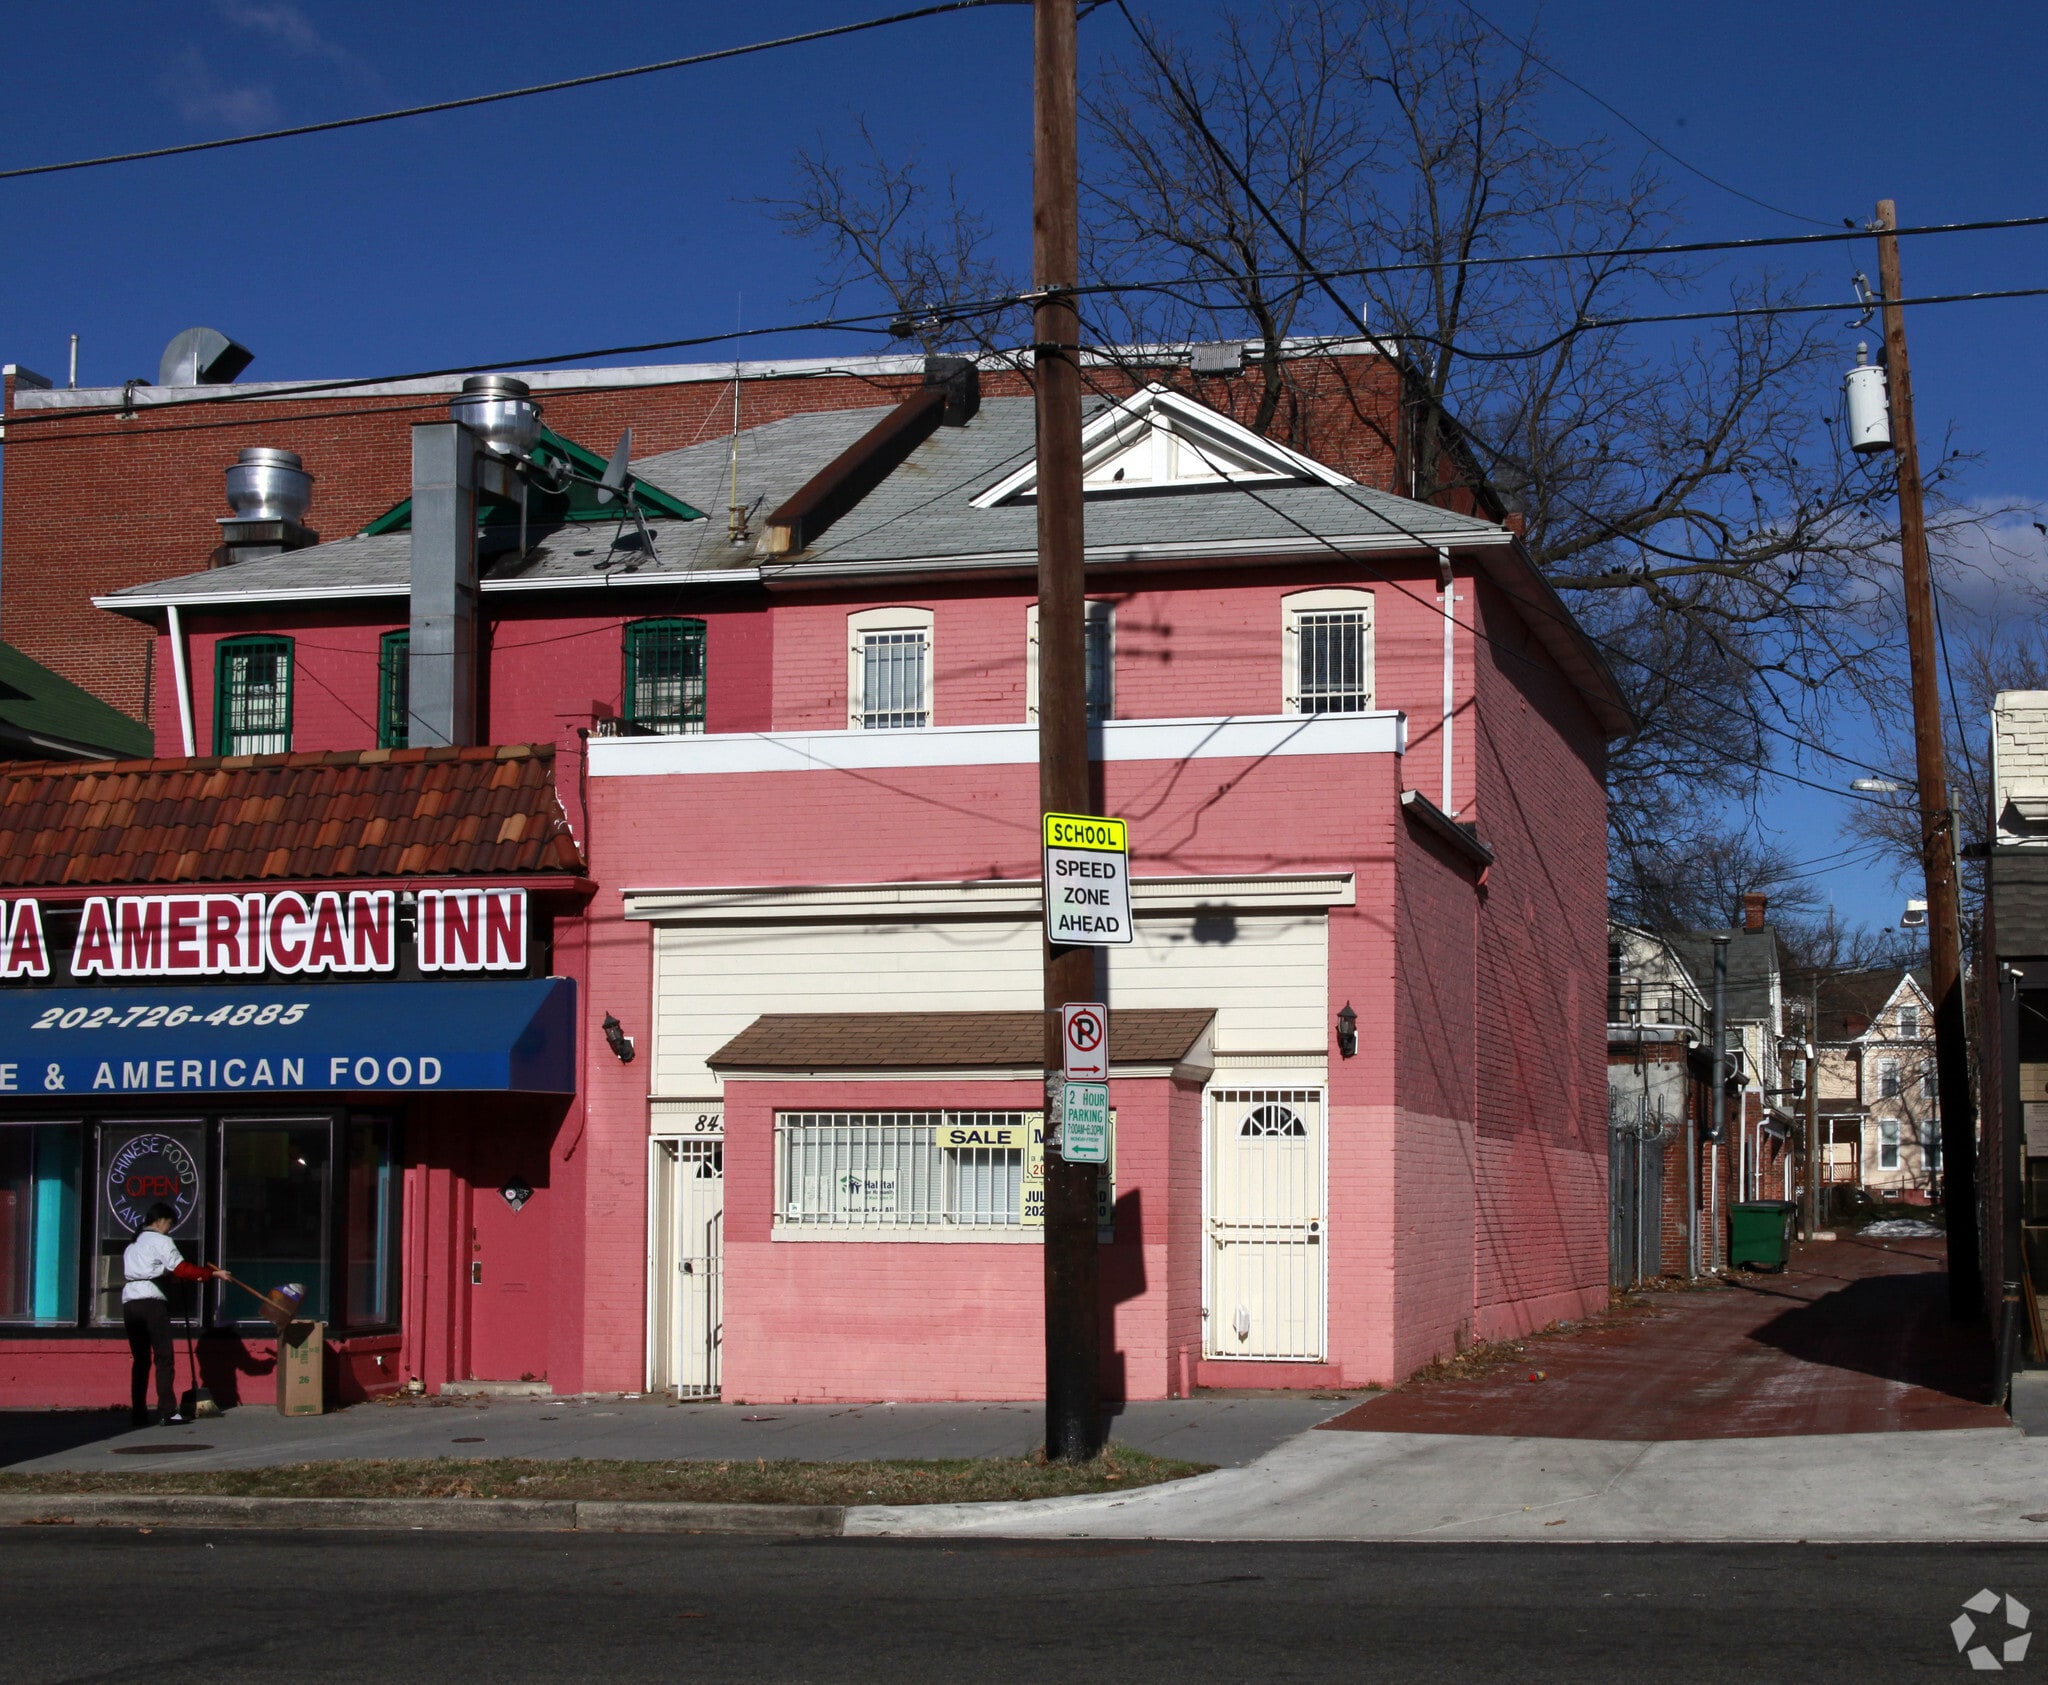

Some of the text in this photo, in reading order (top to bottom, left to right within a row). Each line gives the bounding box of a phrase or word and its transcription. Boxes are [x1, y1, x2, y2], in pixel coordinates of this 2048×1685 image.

[1054, 823, 1117, 845] SCHOOL
[1055, 859, 1116, 879] SPEED
[1064, 887, 1110, 905] ZONE
[0, 888, 527, 977] A AMERICAN INN
[1058, 915, 1120, 932] AHEAD
[31, 1003, 310, 1029] 202-726-4885
[44, 1063, 65, 1090] &
[92, 1058, 305, 1089] AMERICAN
[330, 1057, 442, 1085] FOOD
[1069, 1090, 1105, 1106] 2 HOUR
[1068, 1108, 1103, 1122] PARKING
[950, 1130, 1012, 1144] SALE
[111, 1137, 195, 1184] CHINESE FOOD
[126, 1175, 179, 1197] OPEN
[114, 1195, 146, 1227] TAK
[298, 1375, 310, 1385] 26
